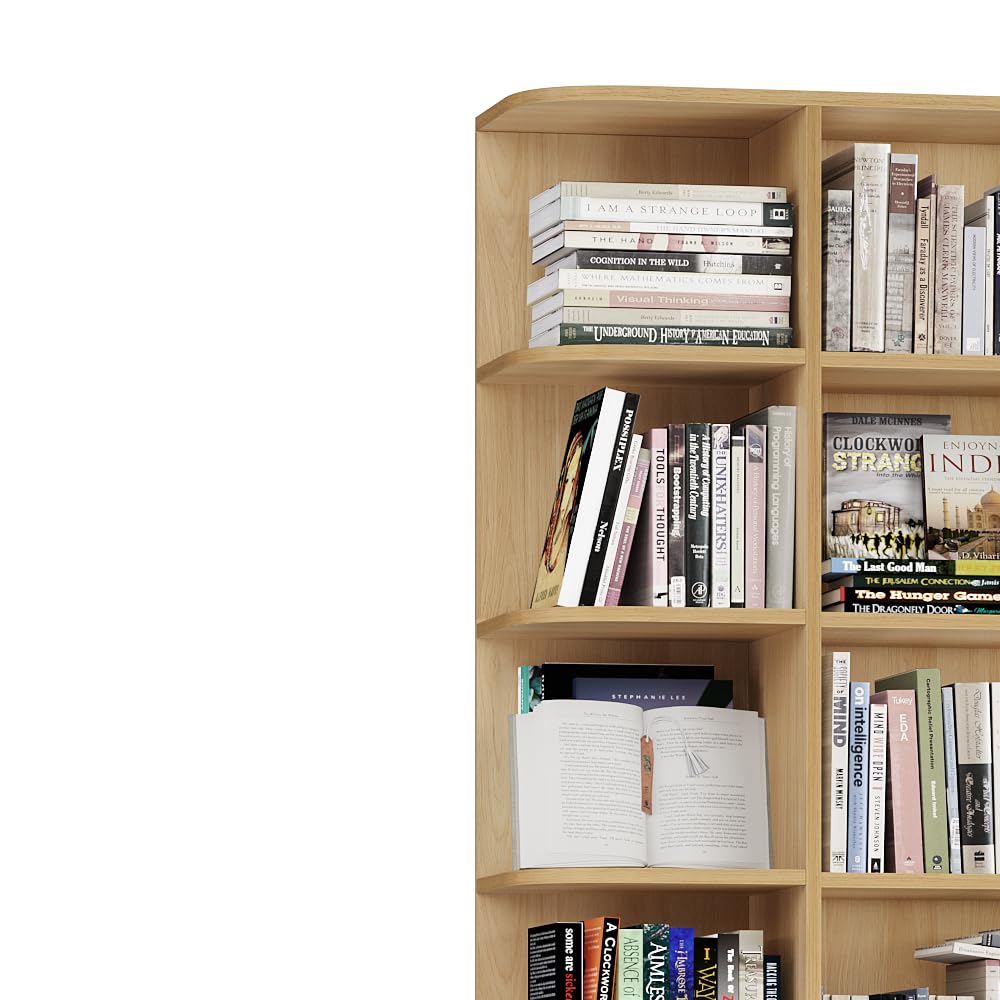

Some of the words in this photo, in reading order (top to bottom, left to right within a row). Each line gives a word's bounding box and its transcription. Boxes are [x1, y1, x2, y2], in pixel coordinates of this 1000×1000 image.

[587, 203, 590, 212] I
[598, 204, 618, 213] AM
[625, 205, 633, 213] A
[641, 205, 709, 216] STRANGE
[716, 207, 758, 217] LOOP
[592, 236, 614, 244] THE
[590, 257, 635, 265] COGNITION
[649, 258, 664, 266] THE
[666, 258, 690, 266] WILD
[620, 274, 693, 282] MATHEMATICS
[697, 277, 733, 285] COMES
[737, 278, 764, 286] FROM
[616, 295, 654, 304] Visual
[659, 296, 709, 305] Thinking
[594, 327, 657, 342] UNDERGROUND
[852, 417, 876, 425] DALE
[879, 418, 922, 426] MCINNES
[613, 409, 634, 471] POSSIPLEX
[656, 449, 665, 484] TOOLS
[671, 467, 681, 537] Bootstrapping
[714, 456, 727, 553] UNIX-HATERS
[655, 507, 665, 561] THOUGHT
[843, 561, 861, 571] The
[863, 562, 885, 571] Last
[887, 562, 913, 572] Good
[915, 563, 936, 572] Man
[865, 577, 880, 585] THE
[882, 577, 919, 586] JERUSALEM
[921, 578, 971, 586] CONNECTION
[855, 590, 886, 600] The
[890, 591, 950, 602] Hunger
[853, 604, 870, 613] THE
[871, 604, 924, 613] DRAGONFLY
[927, 605, 953, 614] DOOR
[854, 687, 864, 705] on
[892, 697, 912, 705] Tukey
[834, 697, 846, 747] MIND
[851, 707, 868, 787] intelligence
[565, 928, 574, 953] some
[565, 955, 573, 972] are
[623, 937, 639, 985] ABSENCE
[624, 987, 640, 998] of
